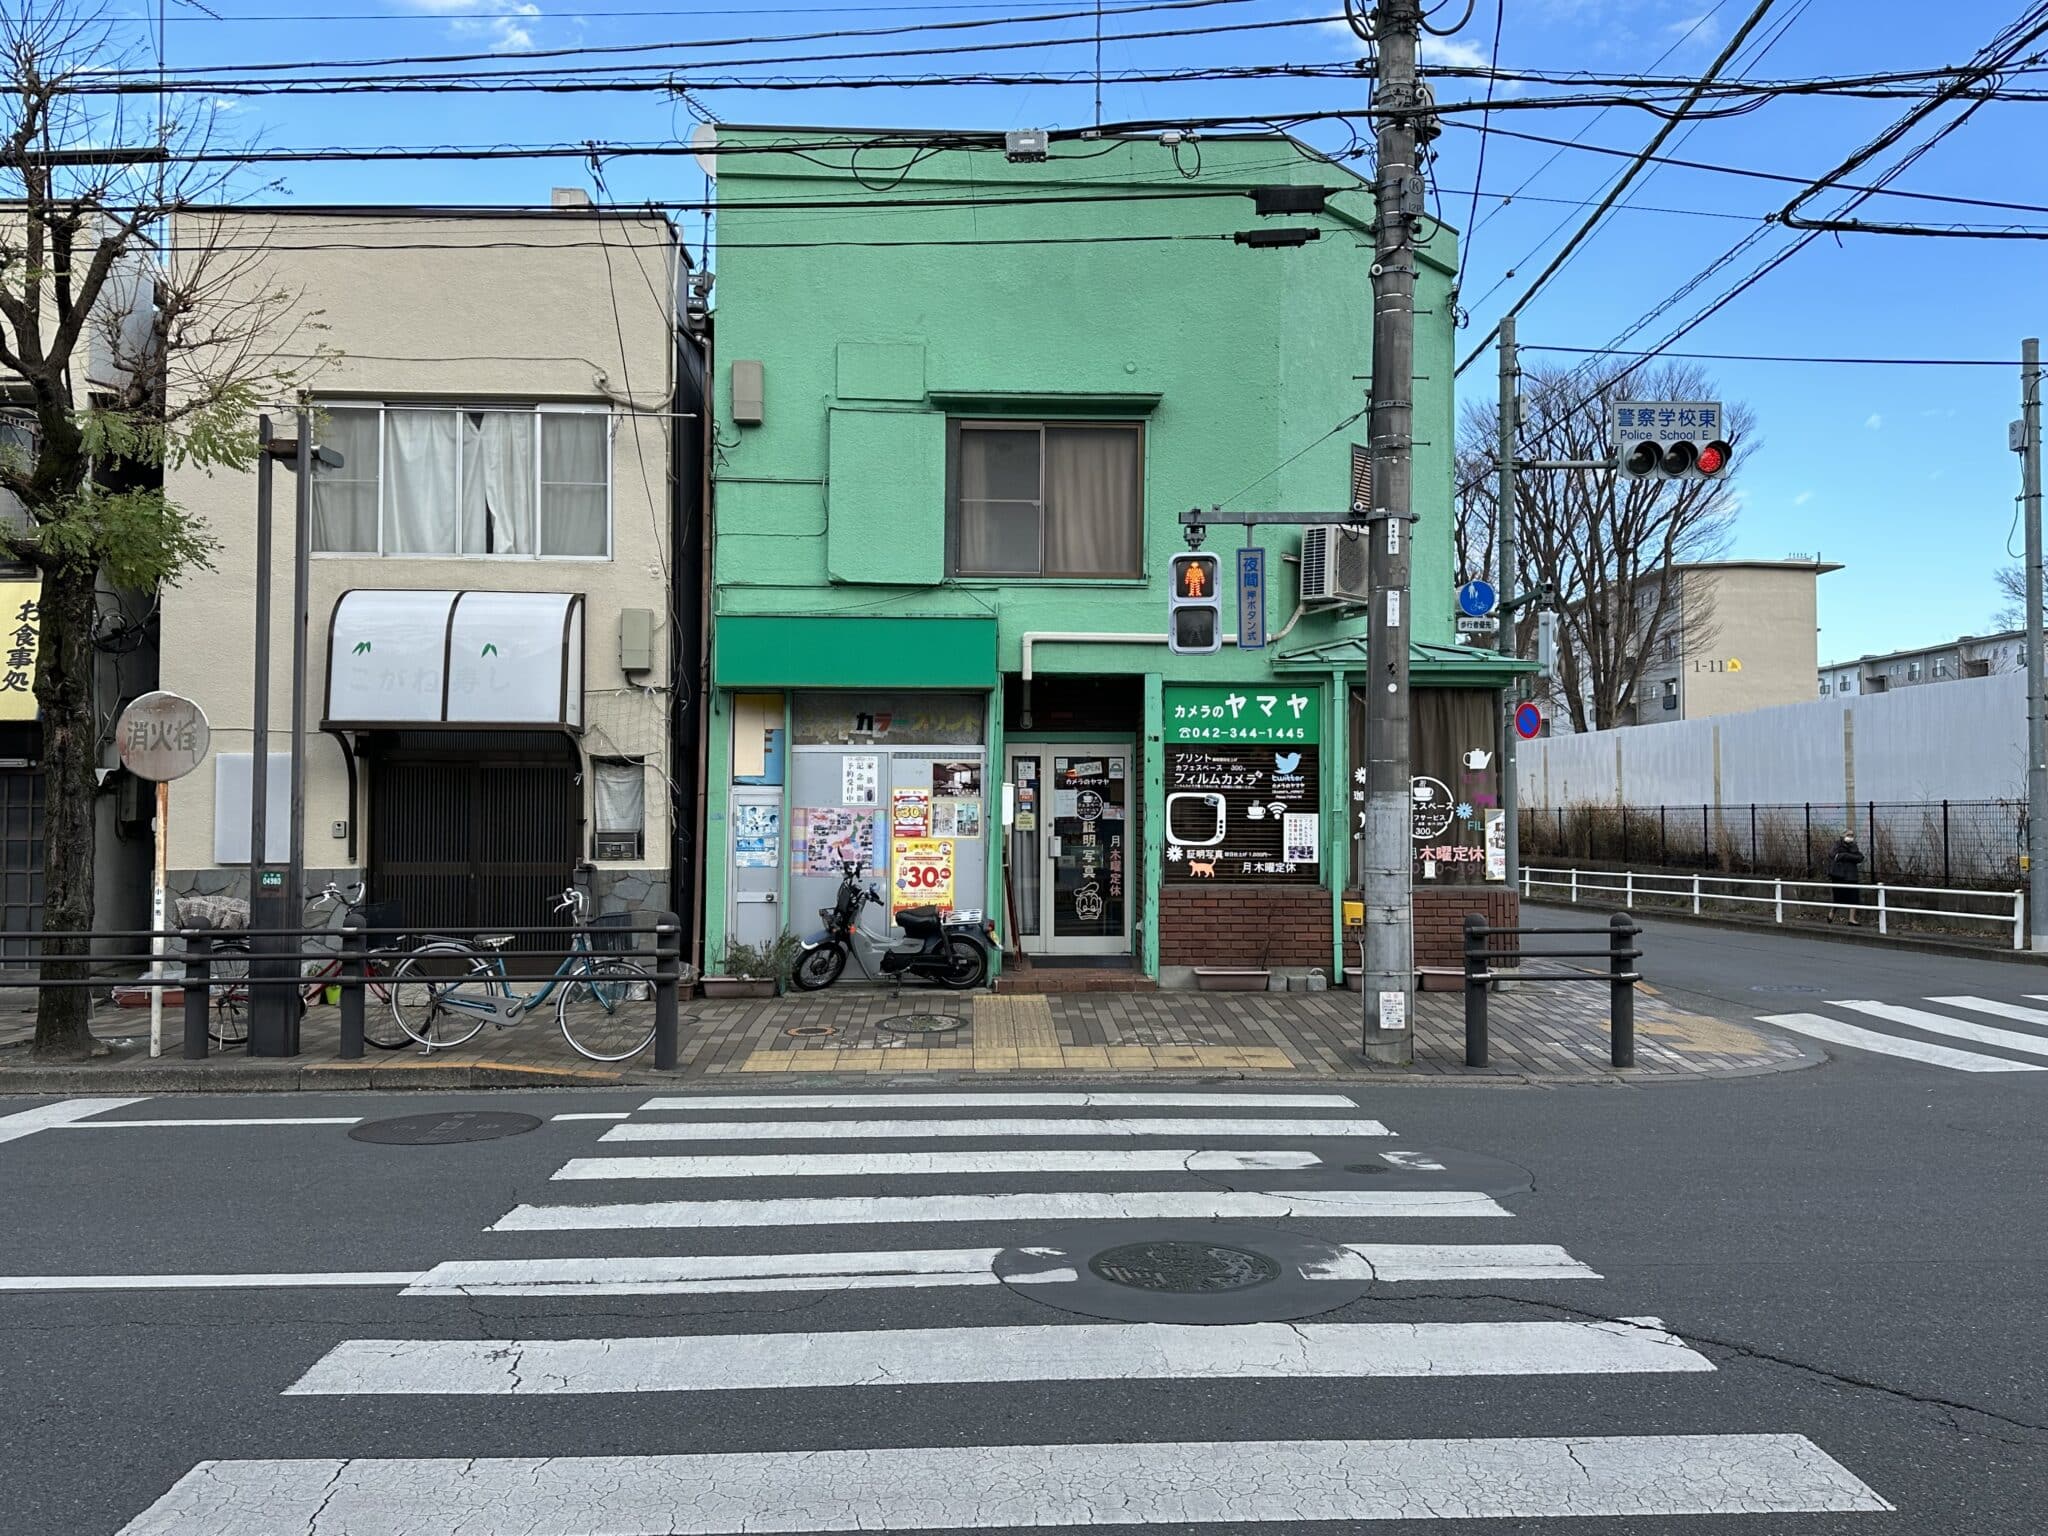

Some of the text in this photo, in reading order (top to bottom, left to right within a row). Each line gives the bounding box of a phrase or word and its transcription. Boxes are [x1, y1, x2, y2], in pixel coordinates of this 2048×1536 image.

[1617, 408, 1716, 428] 警察学校東
[1619, 429, 1712, 441] Police School E.
[1460, 620, 1492, 629] 歩行者優先
[0, 599, 40, 692] お食事処
[1693, 660, 1724, 673] 1-11
[127, 720, 199, 753] 消火栓
[1192, 727, 1305, 739] 042-344-1445
[1175, 753, 1212, 763] プリント
[1079, 764, 1101, 774] OPEN
[1175, 764, 1223, 772] カフェスペース
[846, 762, 854, 802] 予約受付中
[1174, 772, 1257, 785] フィルムカメラ
[1271, 774, 1304, 782] twitter
[1082, 821, 1097, 879] 証明写真
[1186, 849, 1224, 859] 証明写真
